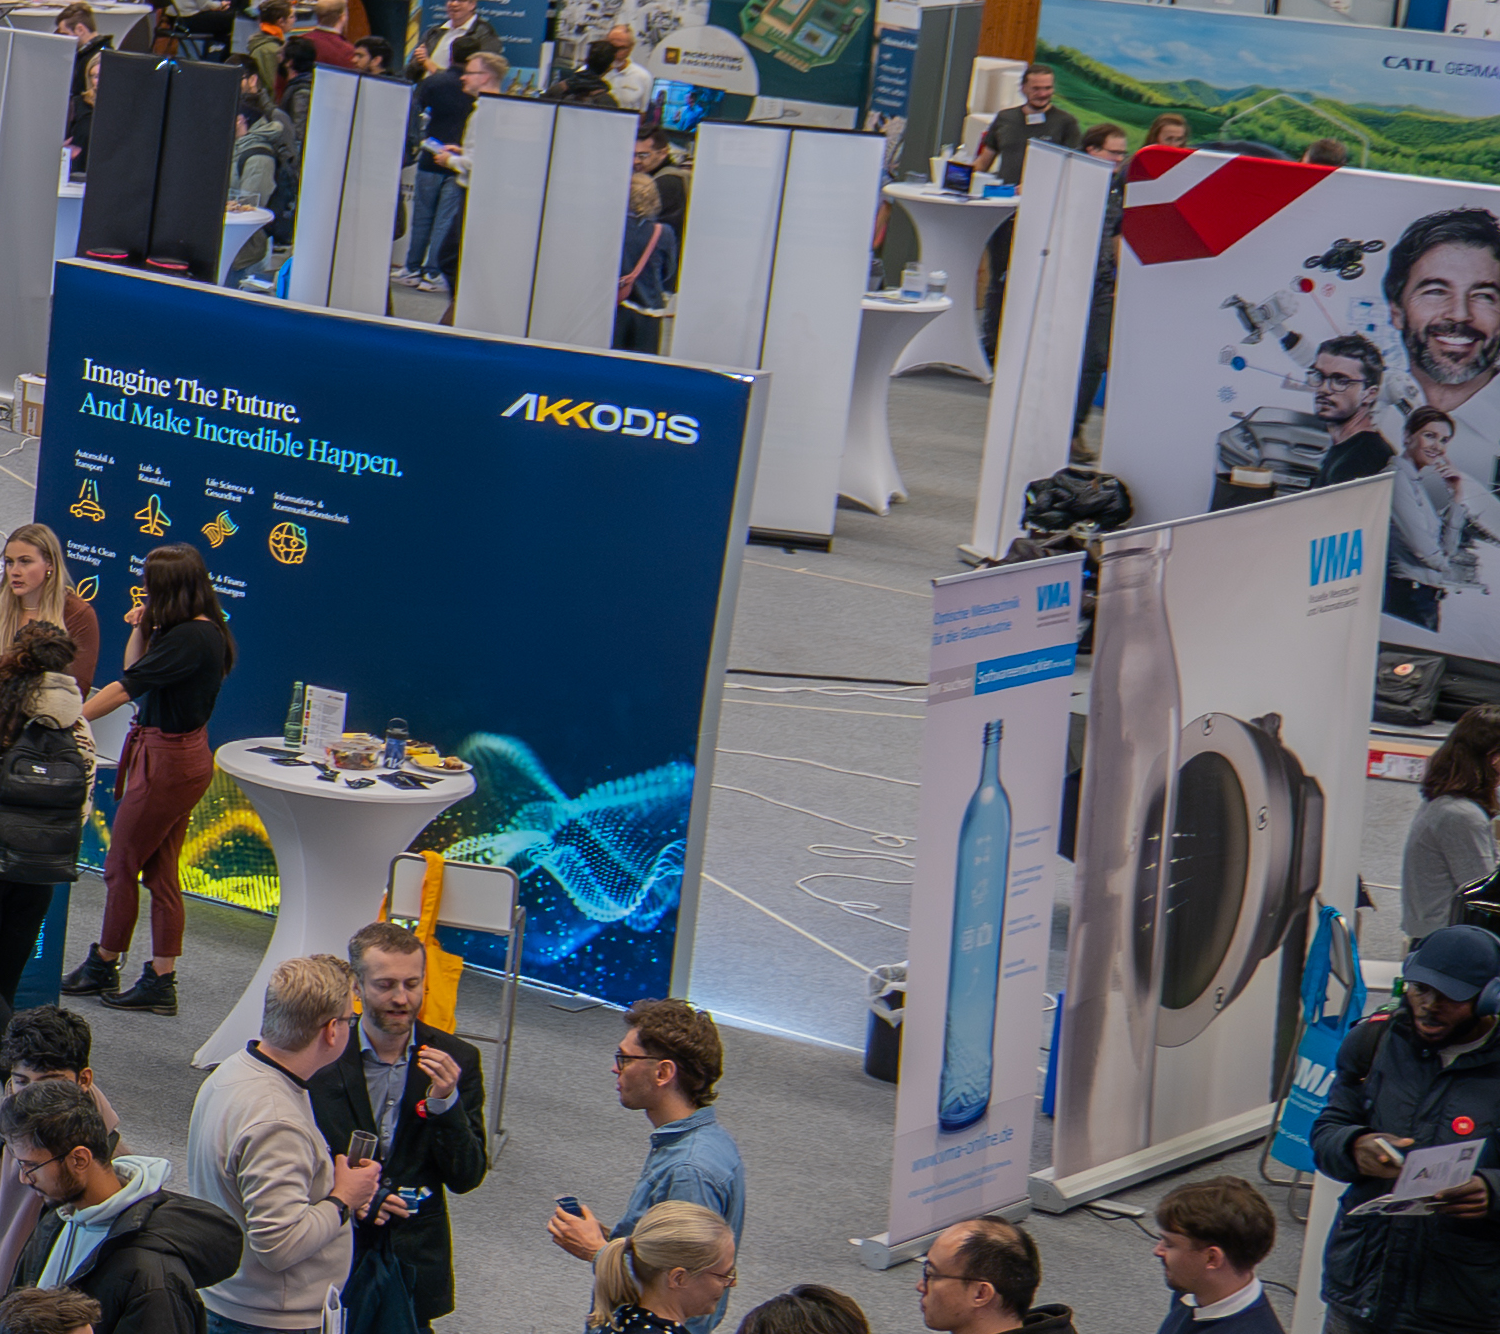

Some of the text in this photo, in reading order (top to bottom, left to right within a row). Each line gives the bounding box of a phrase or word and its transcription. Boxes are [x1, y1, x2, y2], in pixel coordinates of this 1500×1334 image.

[1383, 55, 1500, 79] CATL GERMA
[82, 358, 300, 424] Imagine The Future.
[79, 391, 402, 478] And Make Incredible Happen.
[1309, 528, 1363, 587] VMA
[1037, 580, 1071, 612] VMA
